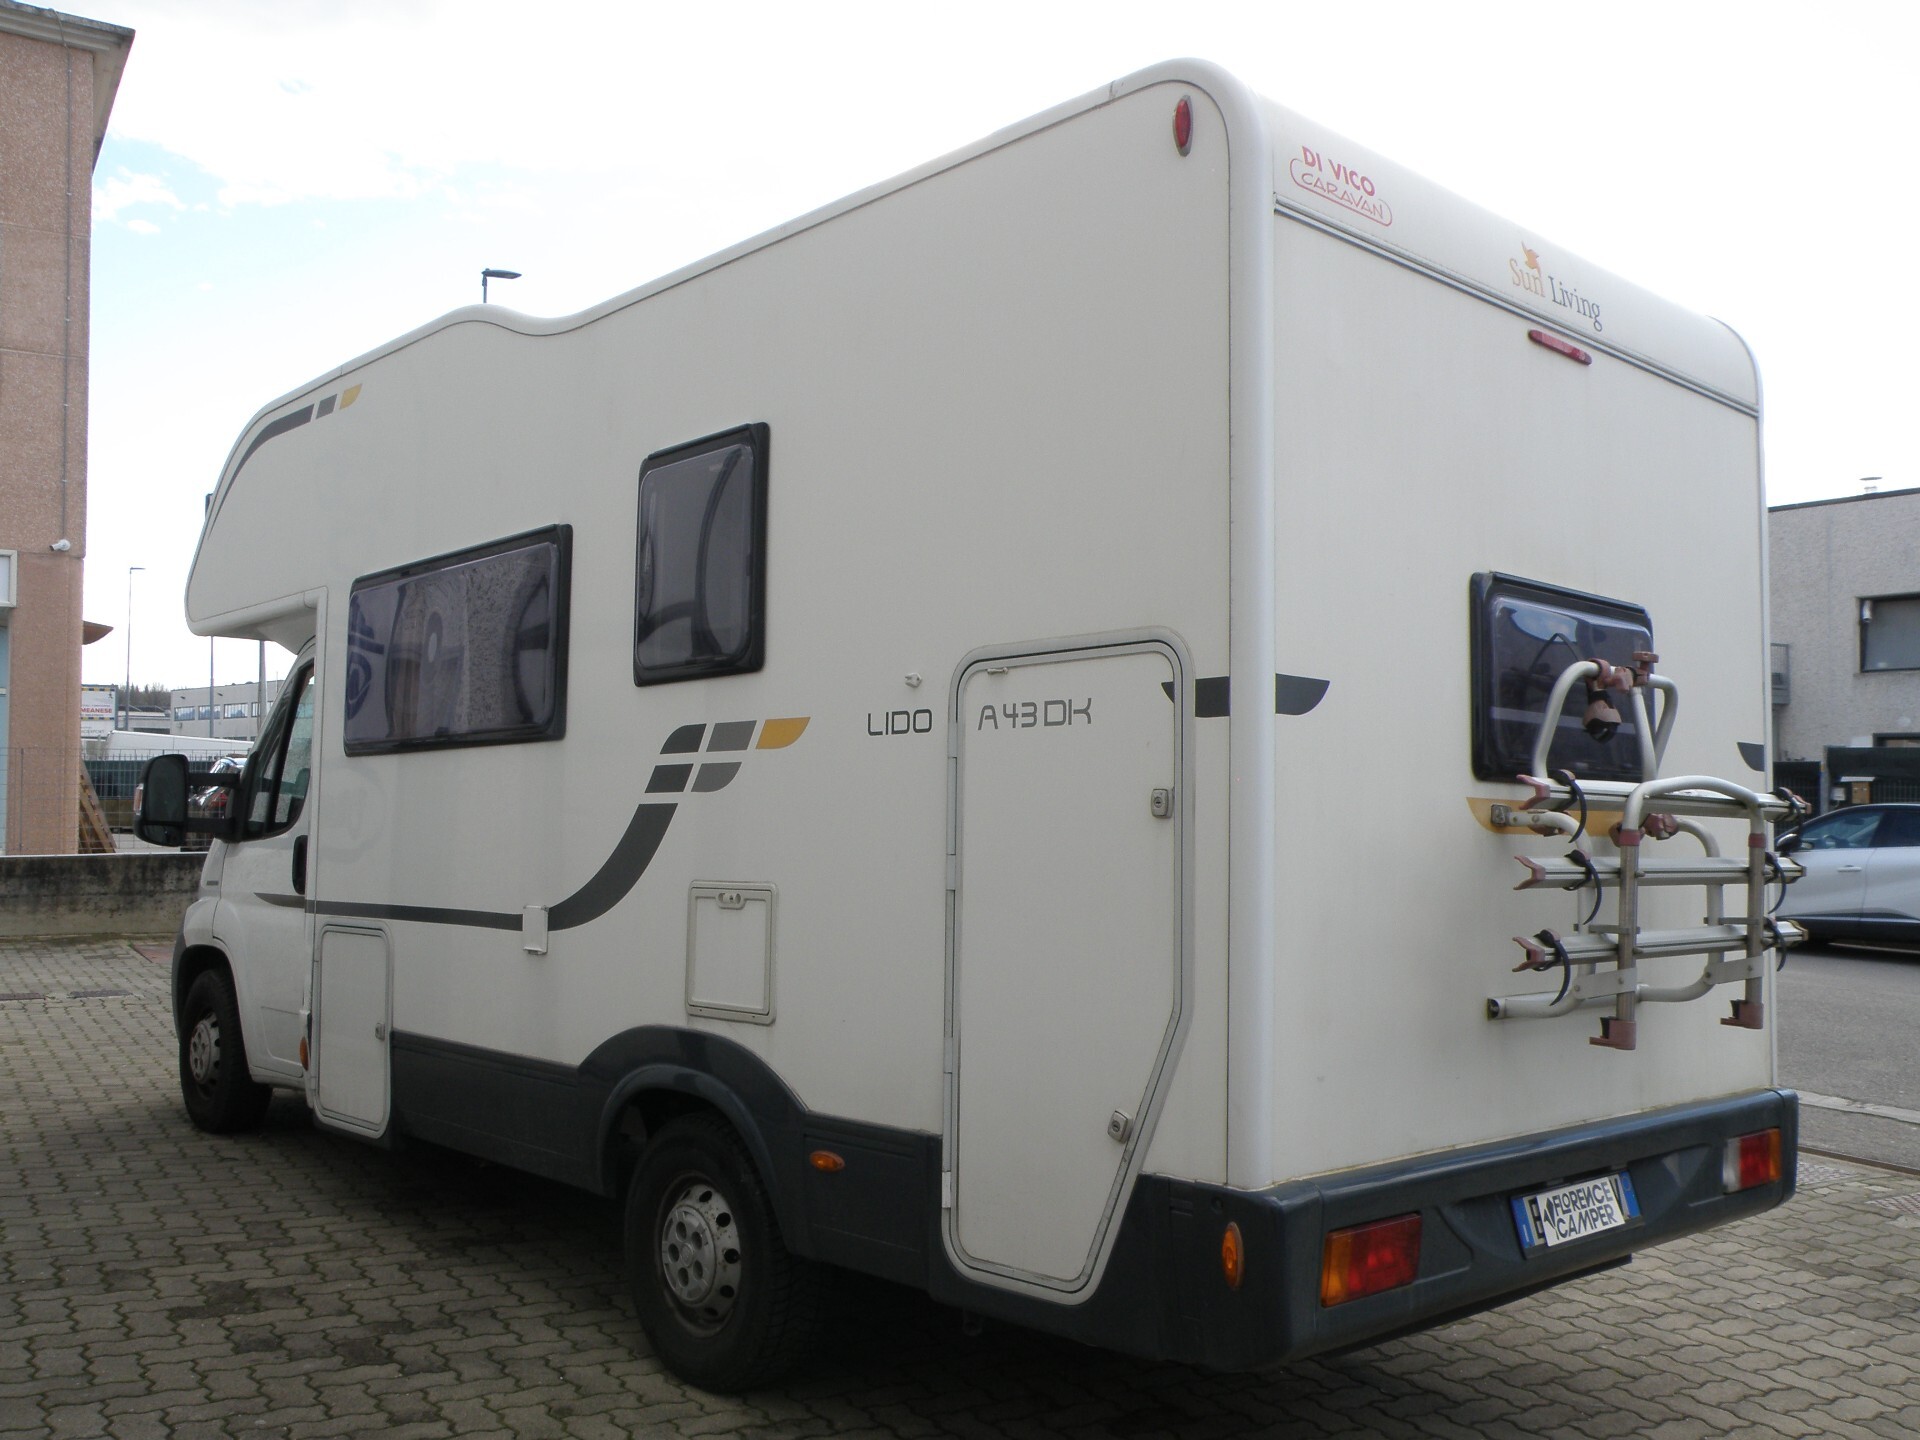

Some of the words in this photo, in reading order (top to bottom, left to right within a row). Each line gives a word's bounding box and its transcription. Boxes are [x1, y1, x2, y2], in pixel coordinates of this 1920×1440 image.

[1302, 146, 1322, 172] DI
[1328, 158, 1375, 197] VICO
[1301, 172, 1384, 219] CARAVAN
[1509, 258, 1546, 298] Sun
[1548, 275, 1603, 332] Living
[867, 708, 933, 736] LIDO
[1552, 1181, 1614, 1217] FLORENCE
[1556, 1203, 1618, 1239] CAMPER
